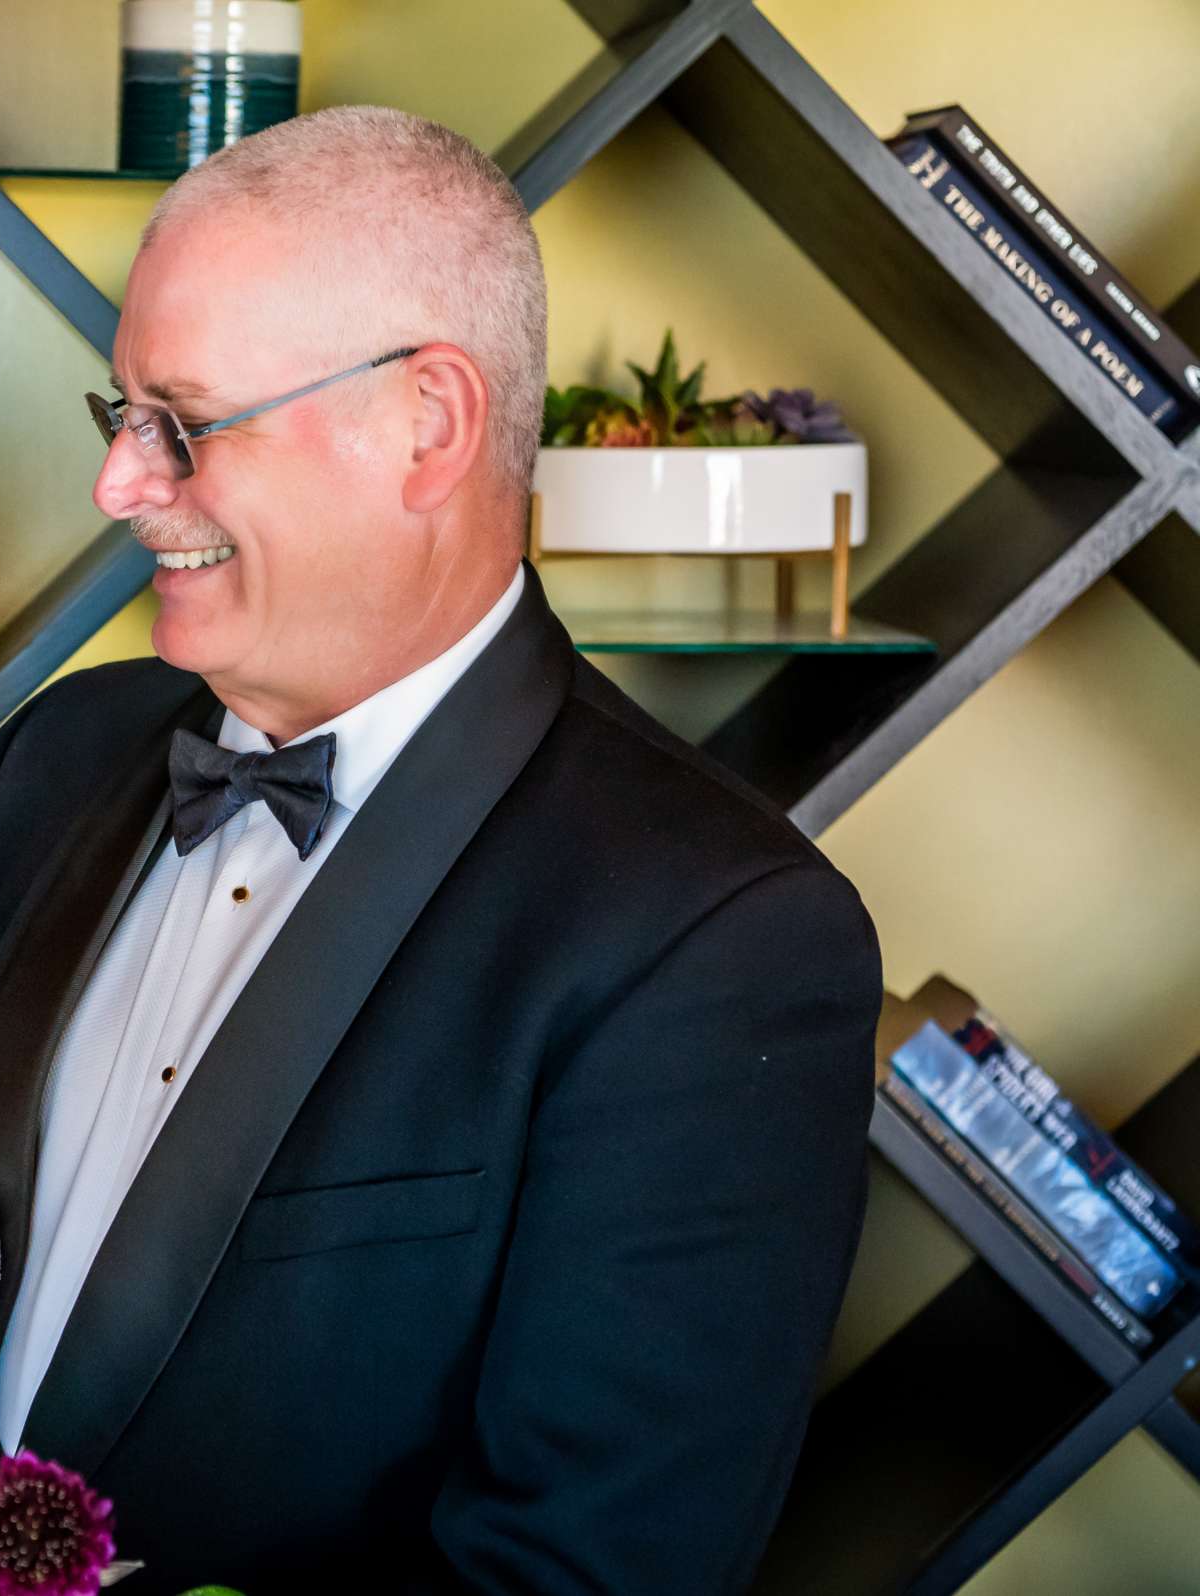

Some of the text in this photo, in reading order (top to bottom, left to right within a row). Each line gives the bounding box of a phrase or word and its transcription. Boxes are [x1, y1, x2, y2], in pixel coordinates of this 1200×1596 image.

[943, 184, 985, 231] THE
[981, 226, 1054, 303] MAKING
[1050, 299, 1081, 328] OF
[1077, 327, 1092, 346] A
[1090, 340, 1145, 398] POEM
